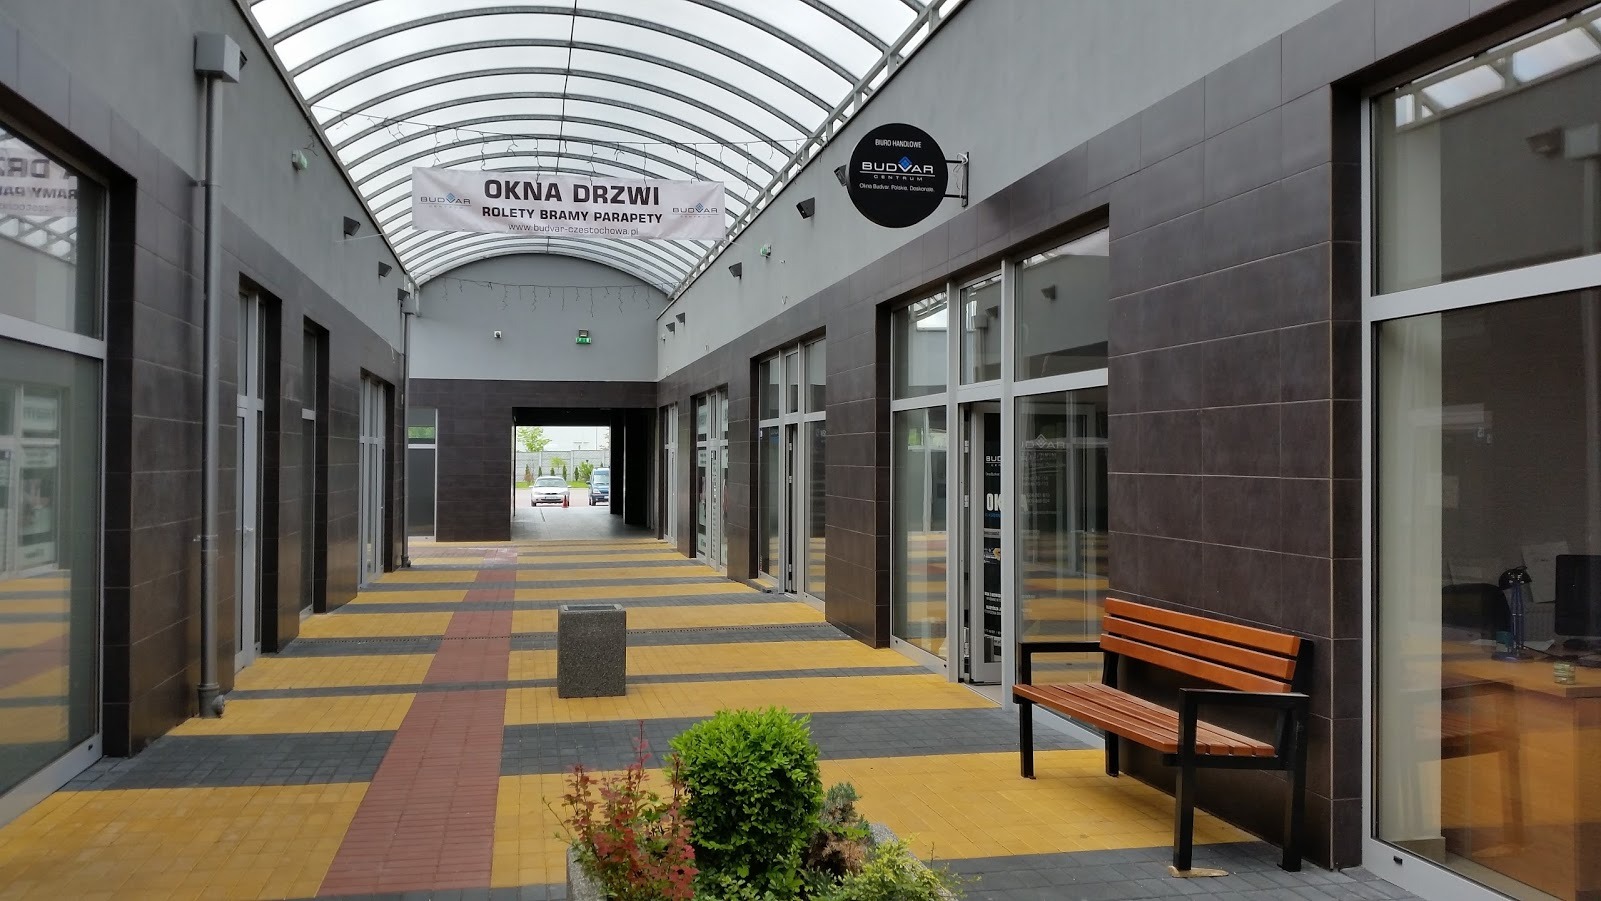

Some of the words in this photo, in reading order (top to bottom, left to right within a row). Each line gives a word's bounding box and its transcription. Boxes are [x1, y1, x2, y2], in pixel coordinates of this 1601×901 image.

[875, 139, 892, 147] BIURO
[892, 140, 922, 148] HANDLOWE
[862, 161, 934, 174] BUDVAR
[484, 179, 563, 202] OKNA
[573, 183, 660, 206] DRZWI
[420, 195, 471, 205] BUDVAR
[482, 206, 535, 219] ROLETY
[540, 209, 589, 222] BRAMY
[594, 211, 663, 224] PARAPETY
[672, 206, 718, 214] BUDVAR
[508, 223, 639, 237] www.budvar-czestochowa.pl
